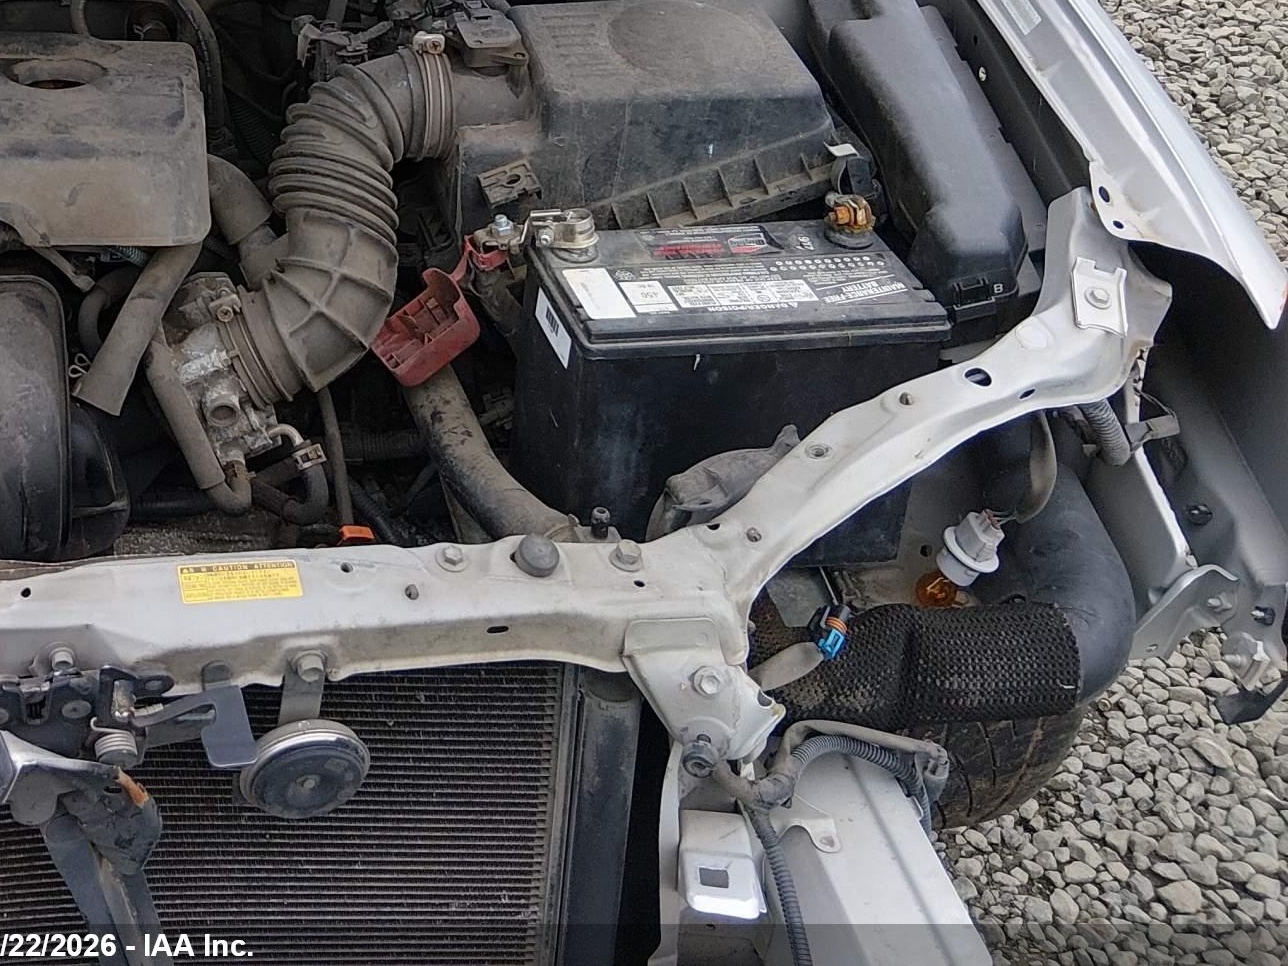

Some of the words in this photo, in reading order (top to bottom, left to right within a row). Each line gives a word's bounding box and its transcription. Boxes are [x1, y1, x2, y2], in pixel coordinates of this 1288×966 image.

[823, 281, 906, 303] MAINTENANCE-FREE
[841, 281, 878, 293] BATTERY
[212, 564, 249, 572] CAUTION
[254, 562, 293, 570] ATTENTION
